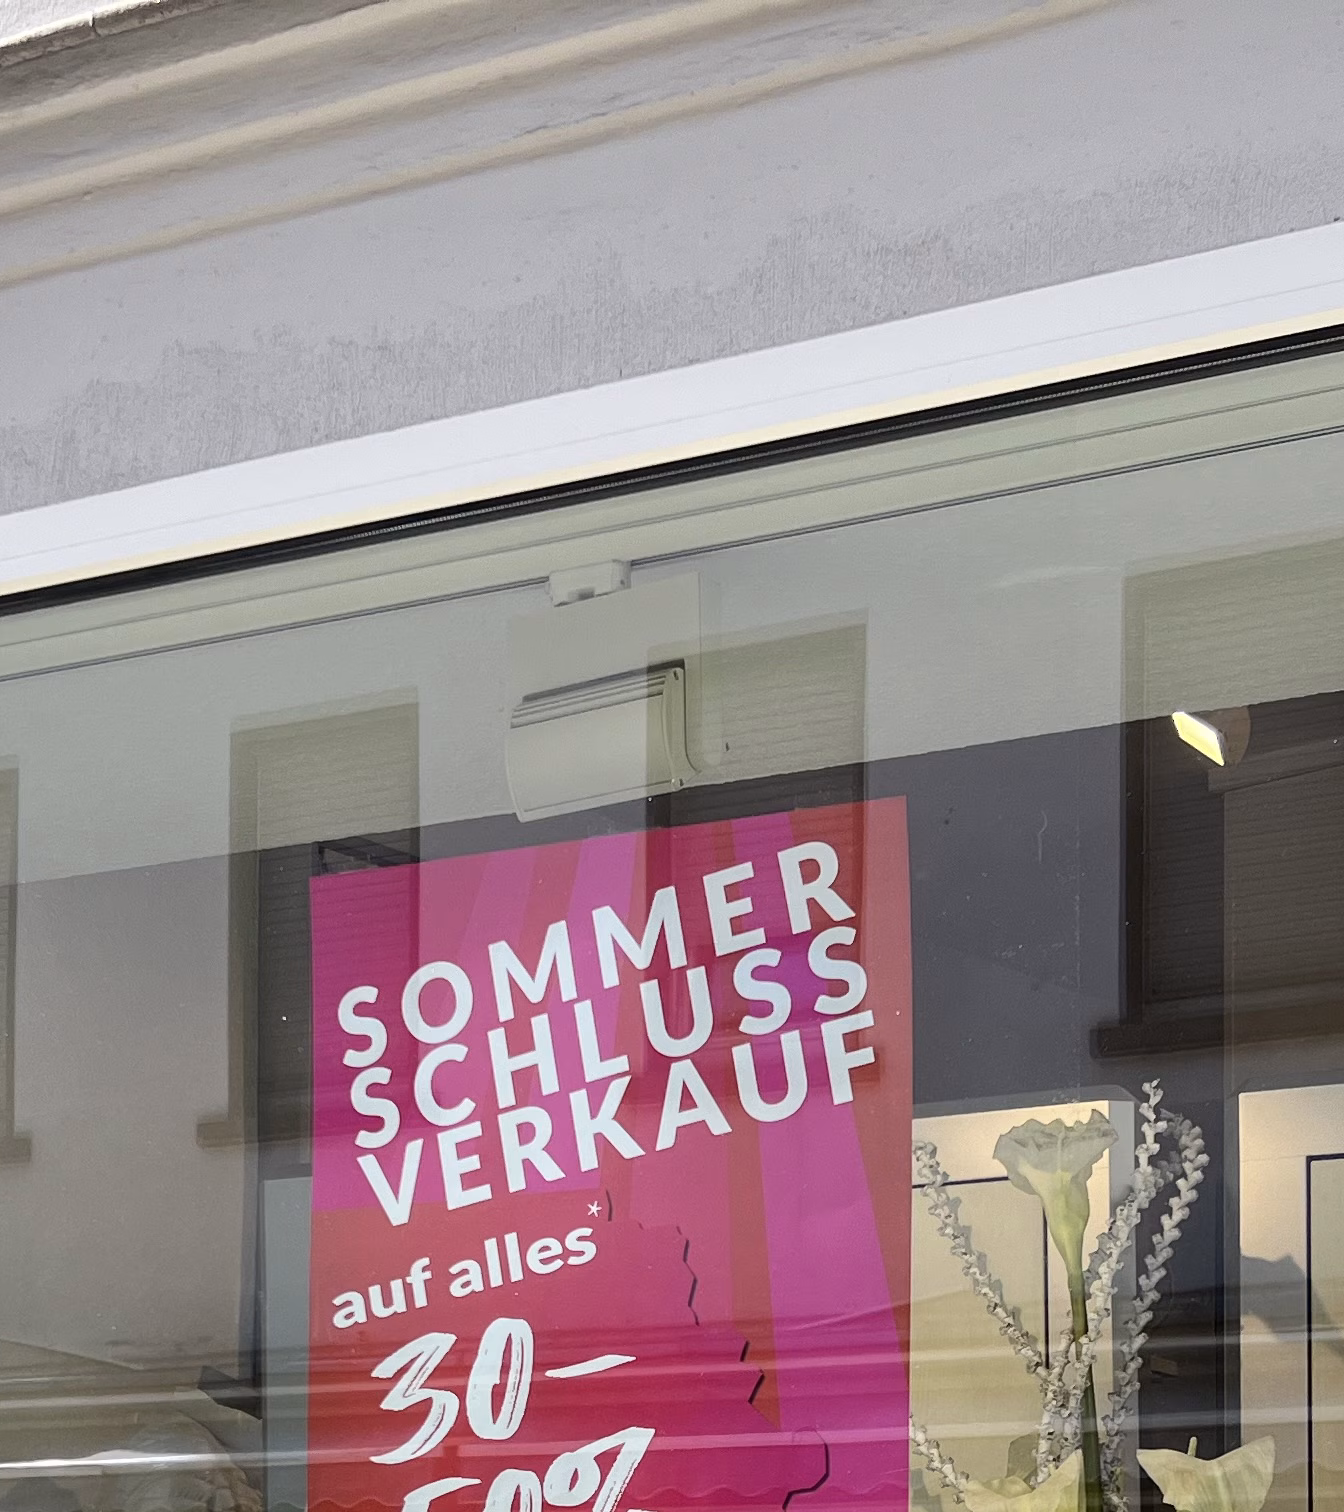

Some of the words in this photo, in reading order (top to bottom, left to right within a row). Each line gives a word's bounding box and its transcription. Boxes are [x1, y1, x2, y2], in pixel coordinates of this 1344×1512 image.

[337, 840, 856, 1068] SOMMER
[350, 926, 868, 1149] SCHLUSS
[356, 1011, 877, 1227] VERKAUF
[331, 1258, 434, 1329] auf
